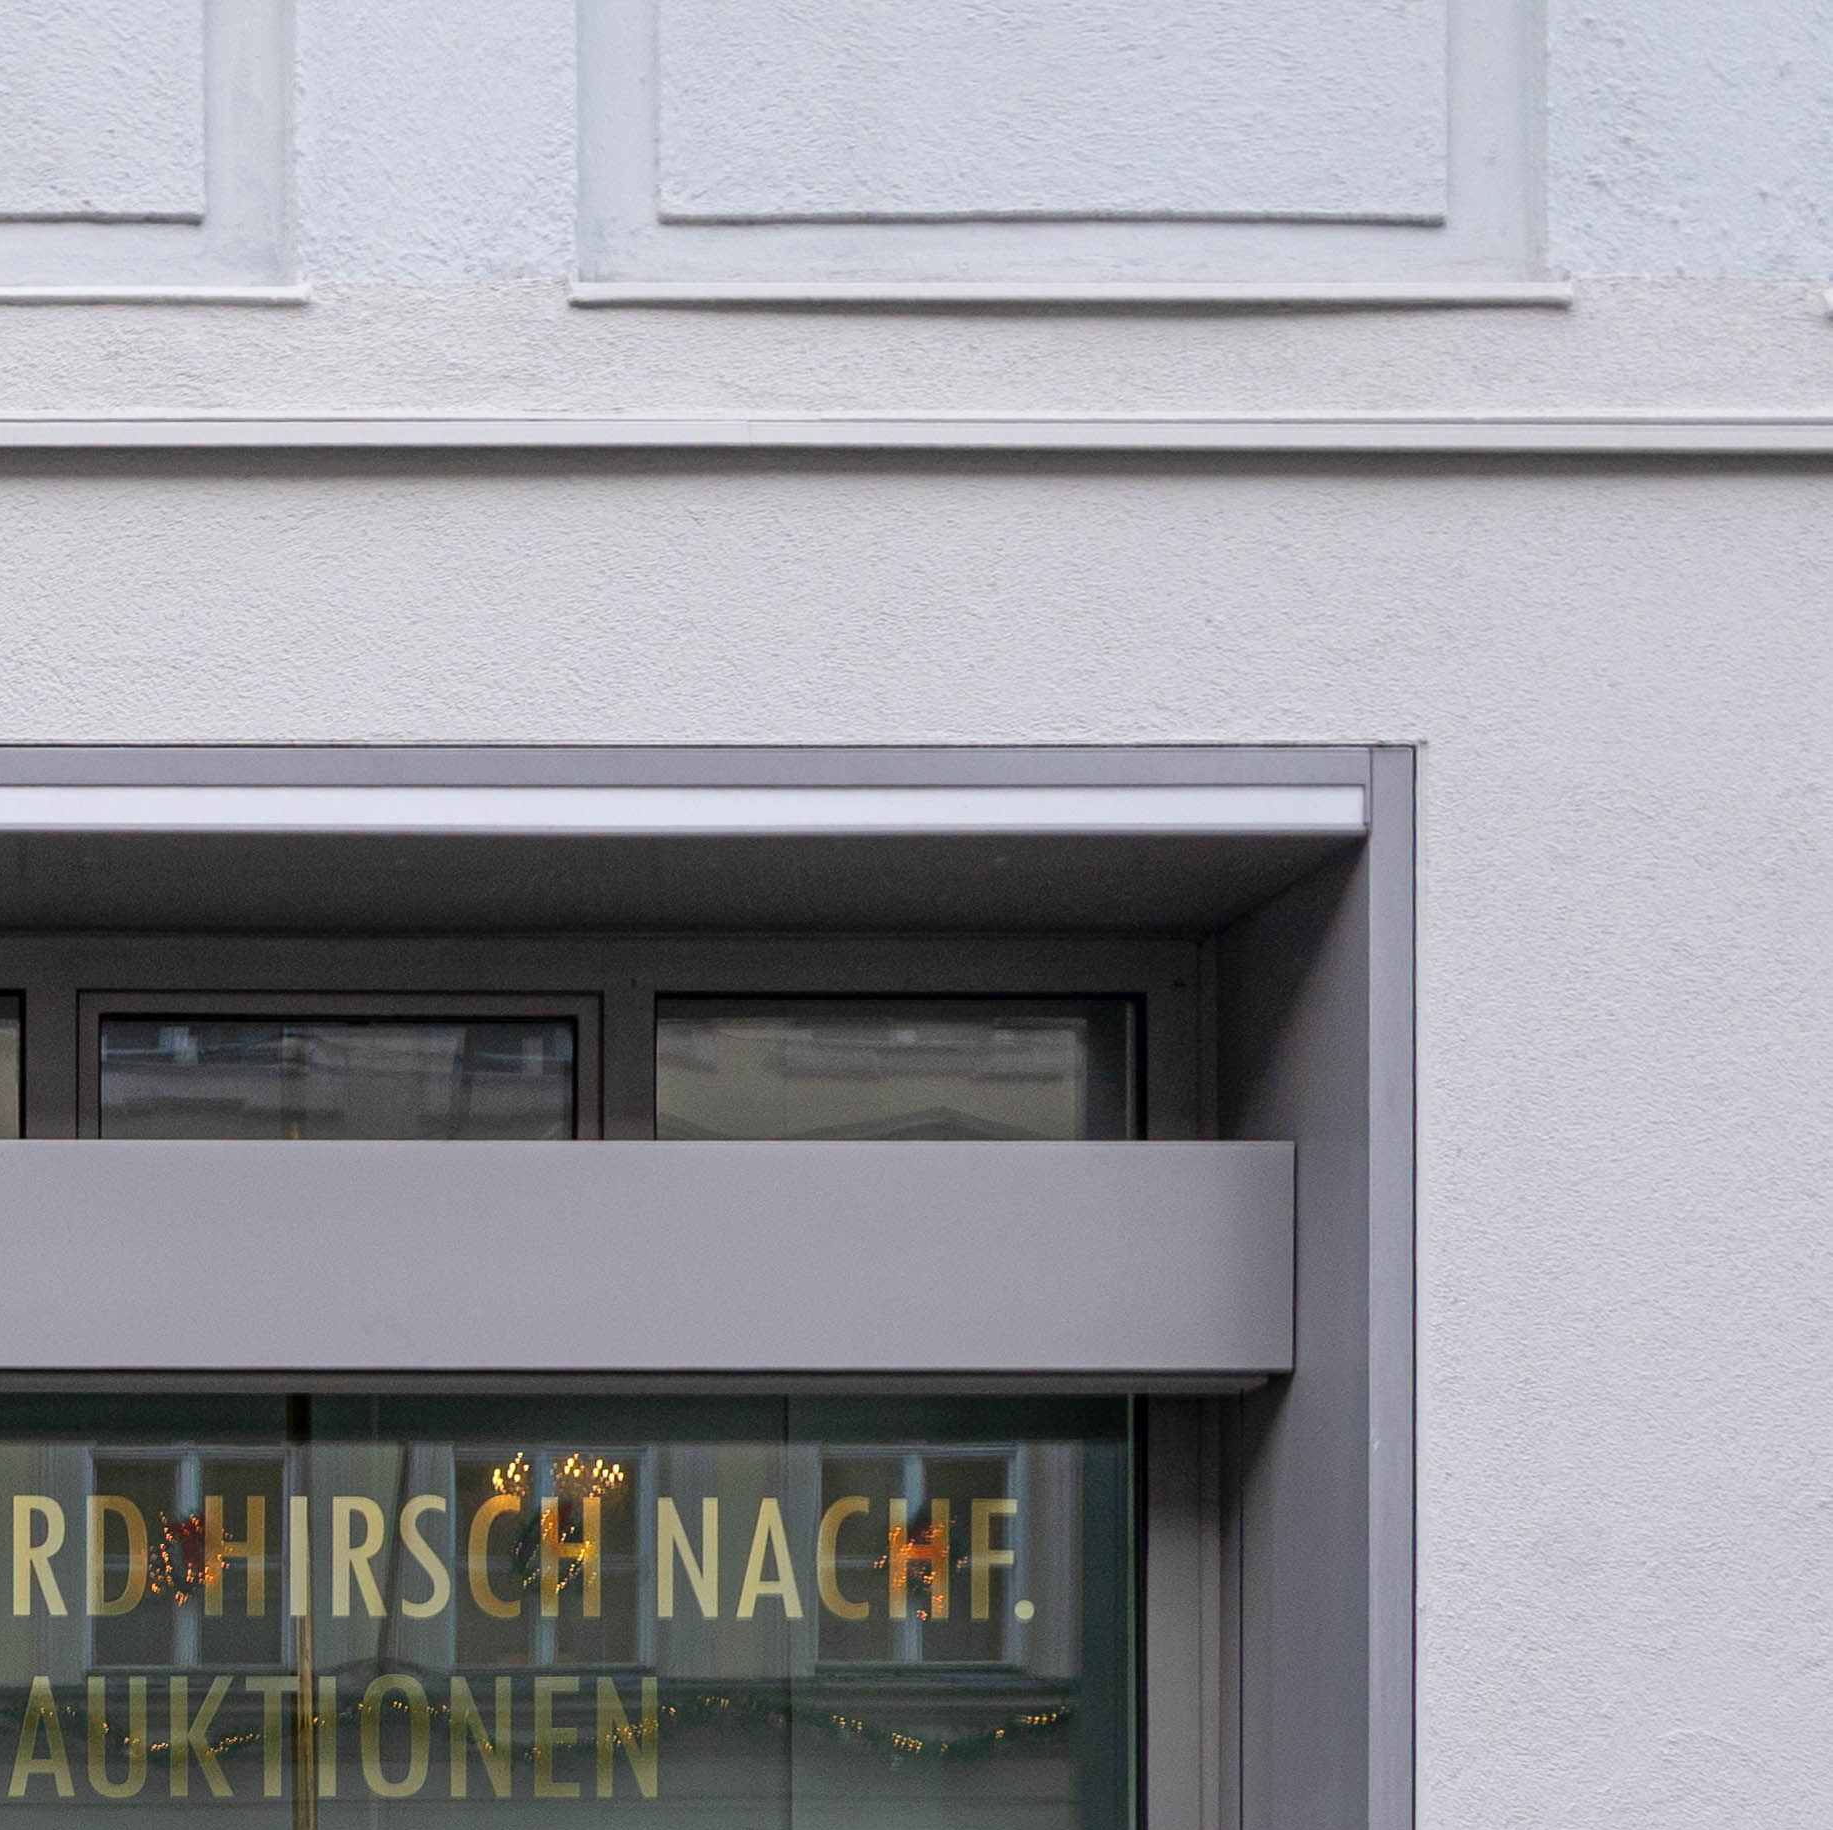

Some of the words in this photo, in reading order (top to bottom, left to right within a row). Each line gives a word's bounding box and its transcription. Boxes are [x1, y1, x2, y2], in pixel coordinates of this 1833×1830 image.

[204, 1493, 602, 1618] HIRSCH
[656, 1495, 1035, 1621] NACHF.
[7, 1672, 658, 1800] AUKTIONEN
